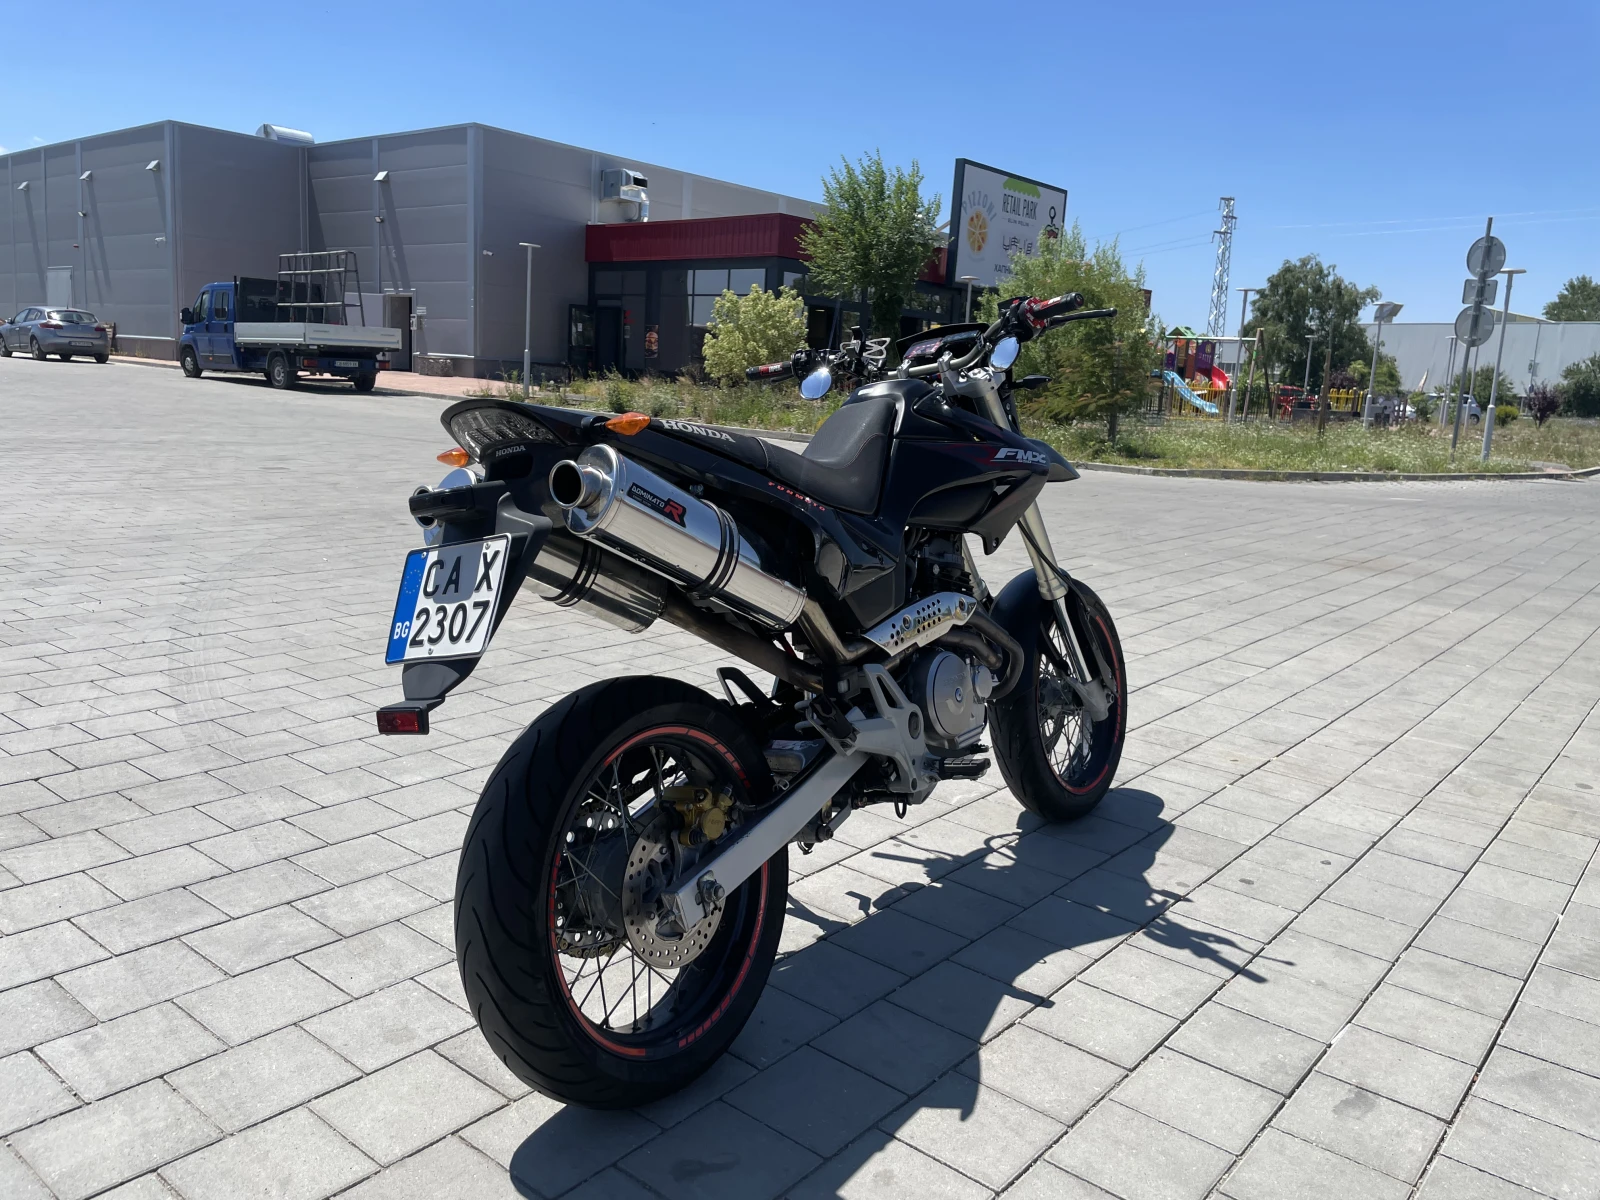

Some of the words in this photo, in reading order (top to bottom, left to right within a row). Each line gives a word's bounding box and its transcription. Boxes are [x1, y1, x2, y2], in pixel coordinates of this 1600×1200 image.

[1002, 193, 1021, 217] RETAIL
[1022, 198, 1039, 220] PARK
[659, 420, 736, 442] HONDA
[495, 445, 526, 457] HONDA
[994, 447, 1046, 463] FMX
[423, 556, 461, 598] CA
[474, 550, 501, 591] X
[393, 621, 410, 639] BG
[409, 600, 490, 647] 2307
